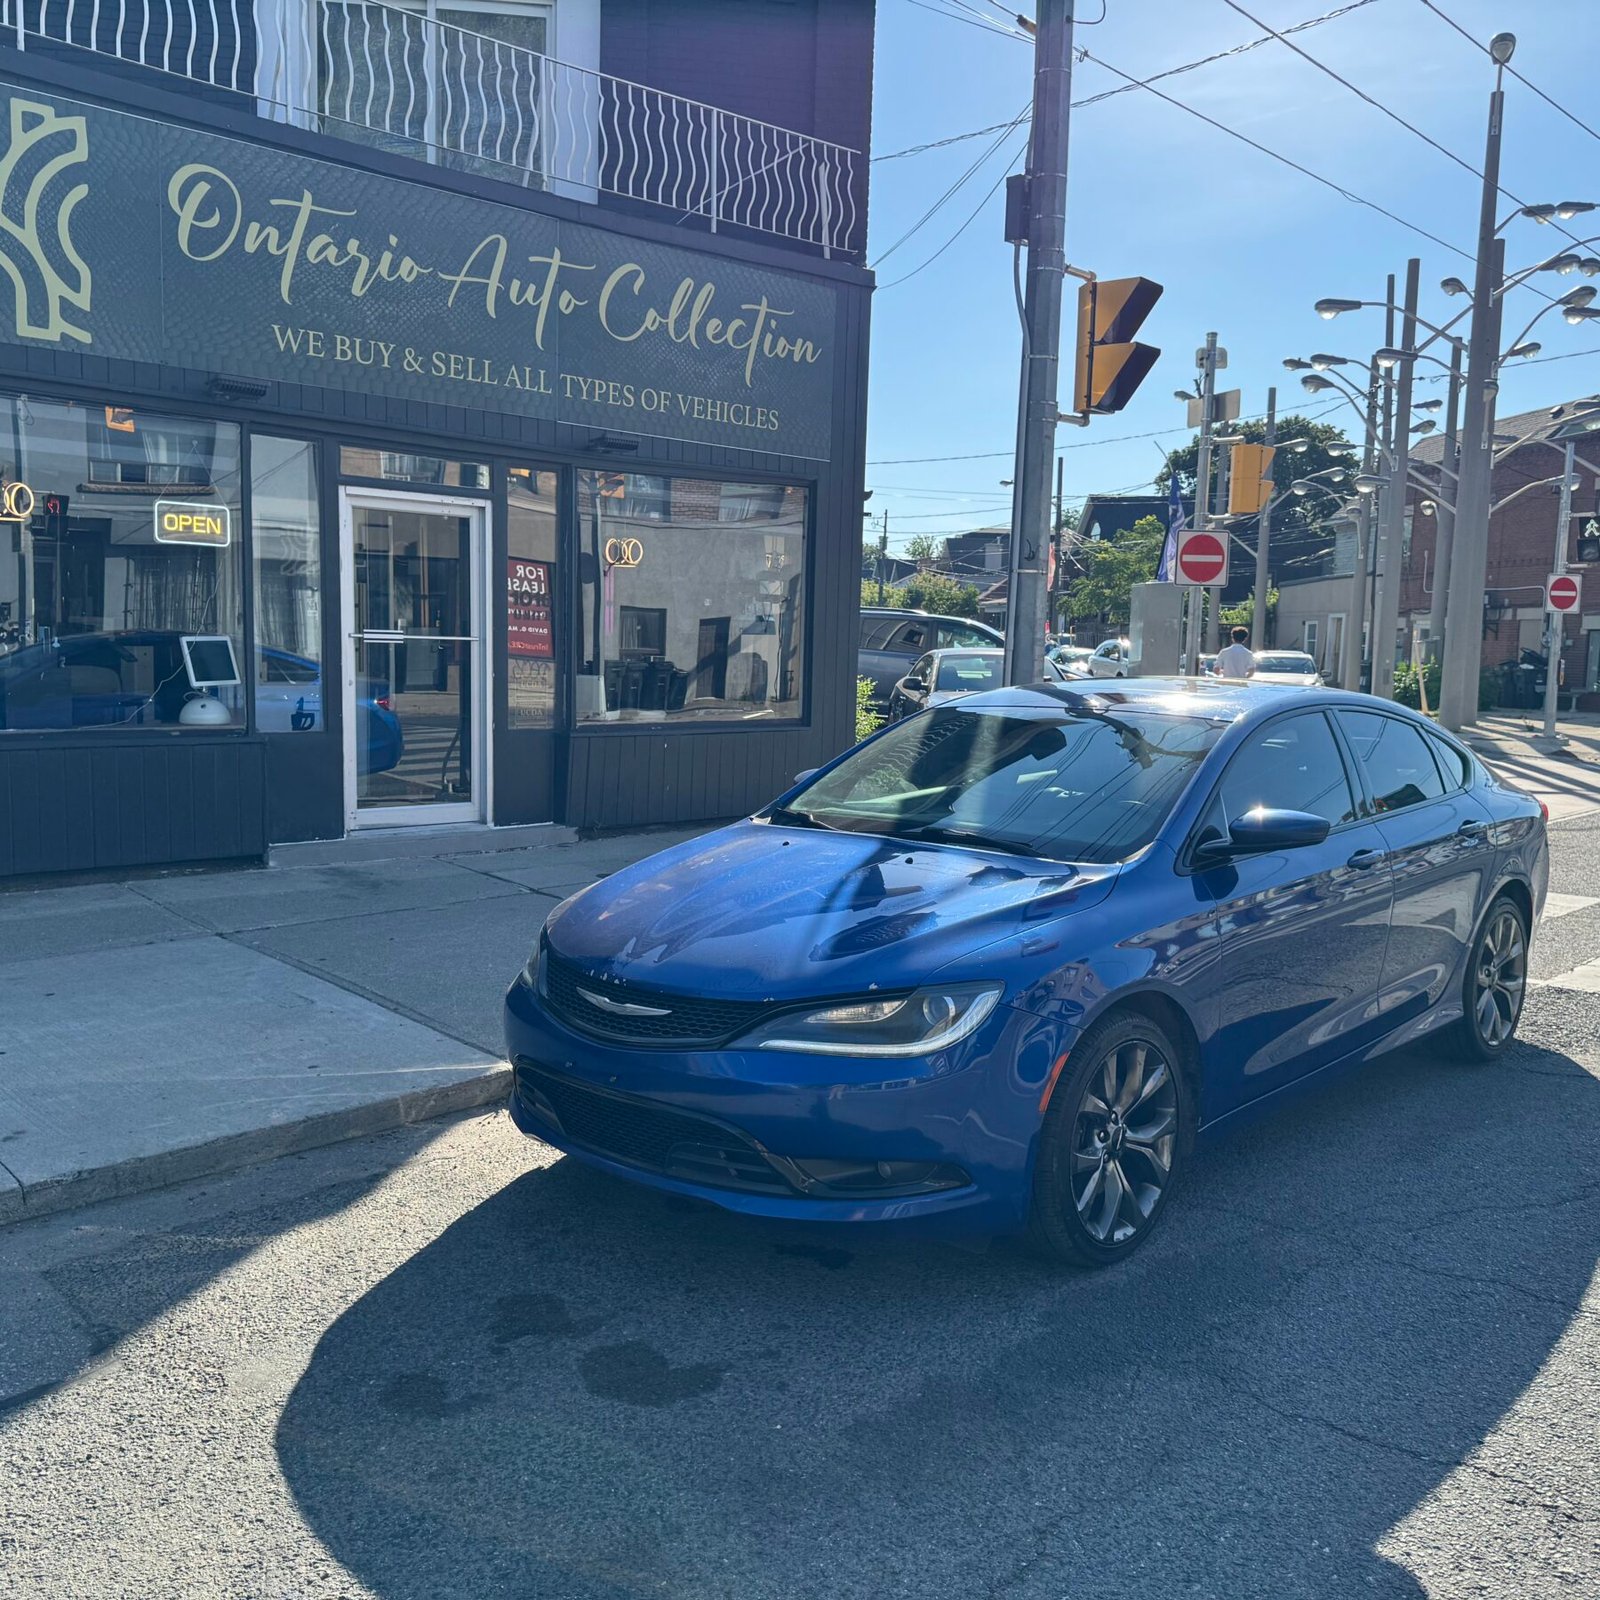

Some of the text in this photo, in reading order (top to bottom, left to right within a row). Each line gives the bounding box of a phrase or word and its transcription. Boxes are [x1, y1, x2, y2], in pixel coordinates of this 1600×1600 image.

[167, 163, 822, 388] Ontario Auto Collection
[271, 324, 779, 431] WE BUY & SELL ALL TYPES OF VEHICLES
[163, 513, 222, 535] OPEN
